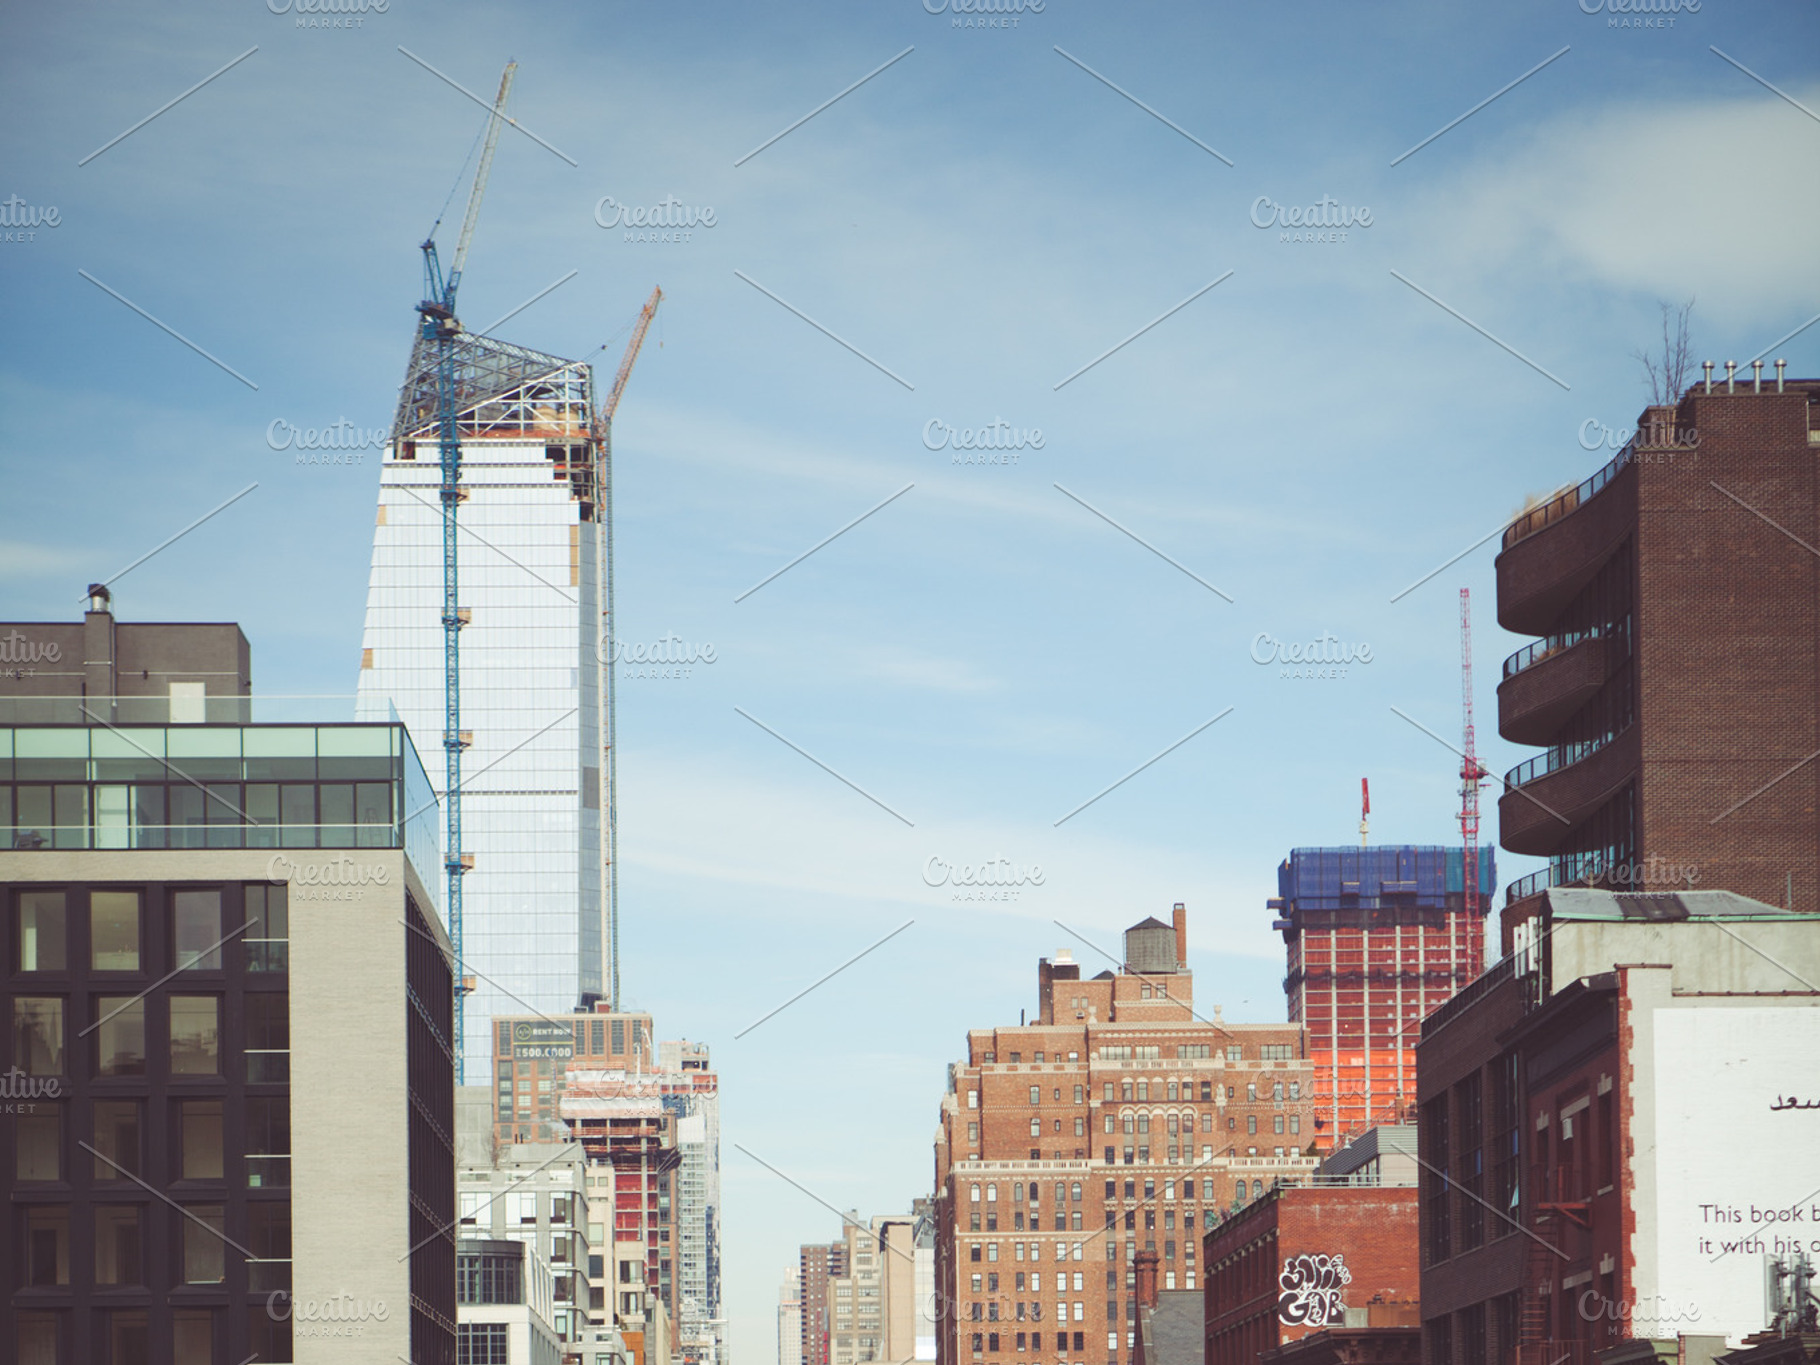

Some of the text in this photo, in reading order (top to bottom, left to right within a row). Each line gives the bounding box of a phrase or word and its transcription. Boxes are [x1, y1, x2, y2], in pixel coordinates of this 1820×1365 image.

[1698, 1204, 1742, 1223] This
[1750, 1204, 1803, 1223] book
[1699, 1236, 1713, 1254] it
[1721, 1234, 1765, 1254] with
[1774, 1235, 1802, 1254] his
